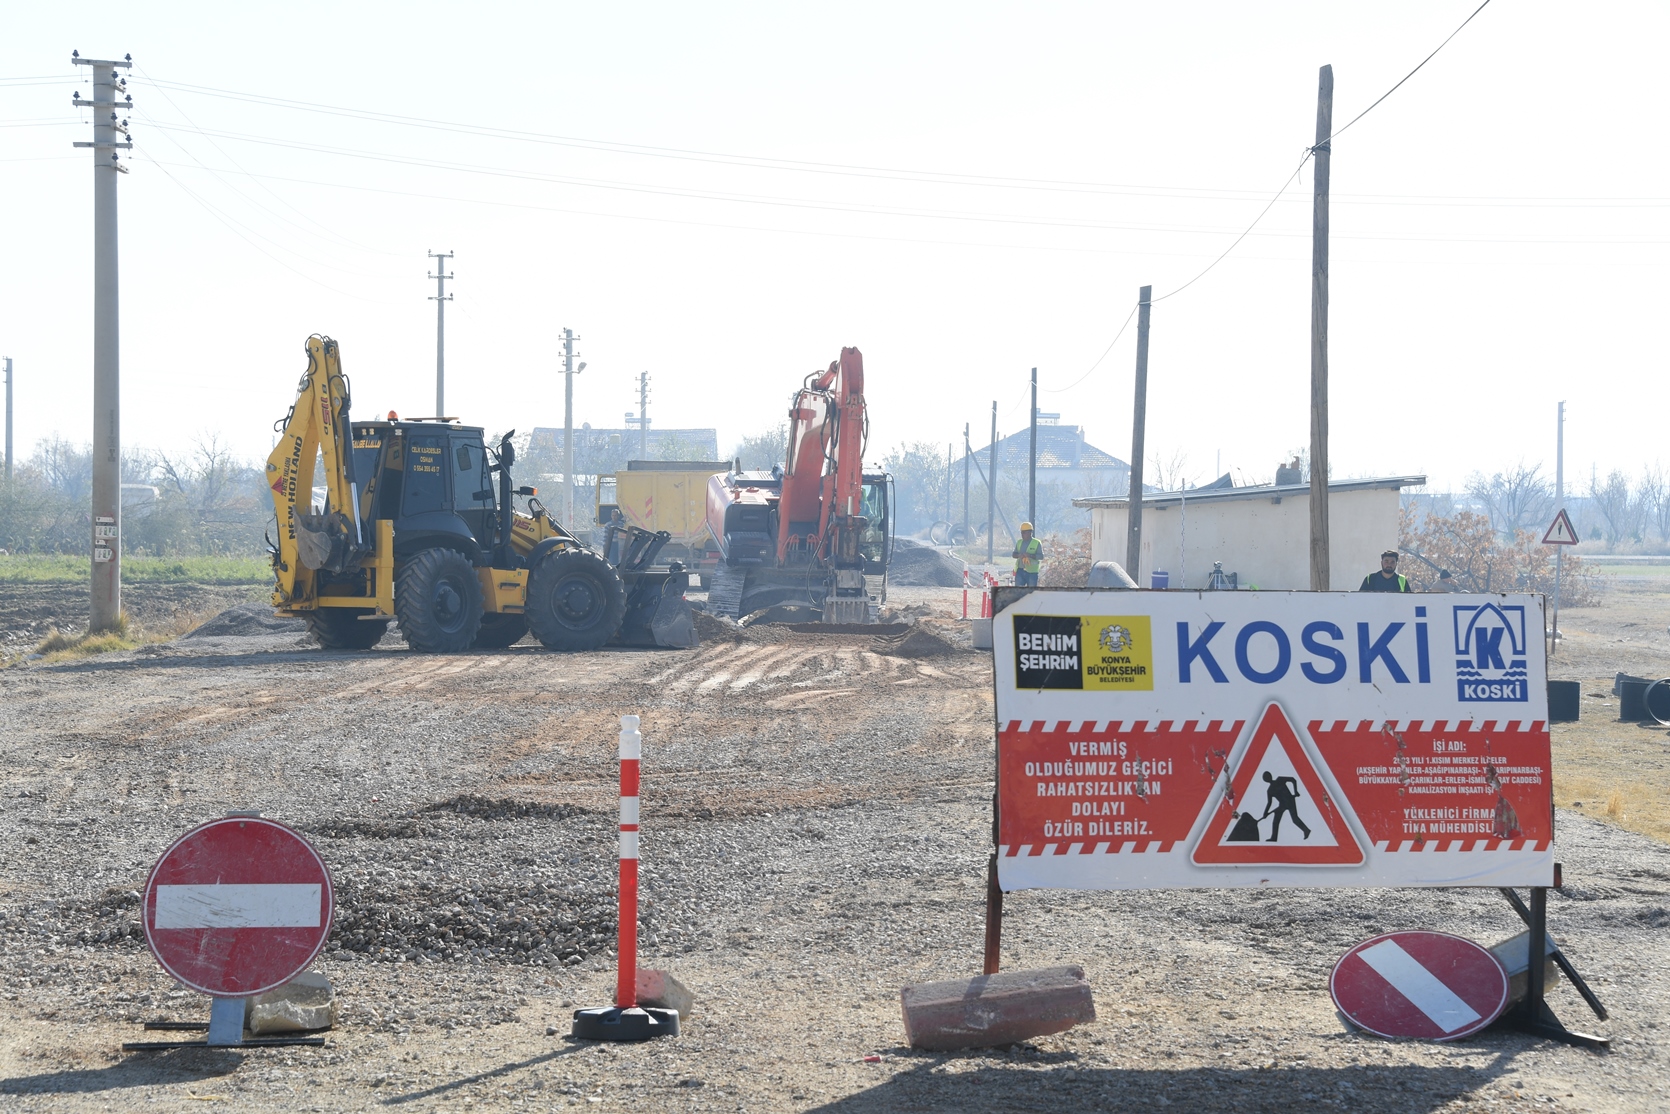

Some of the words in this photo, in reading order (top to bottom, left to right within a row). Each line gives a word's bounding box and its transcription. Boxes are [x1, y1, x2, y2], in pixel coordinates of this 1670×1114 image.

[1018, 632, 1078, 652] BENİM
[1176, 606, 1431, 684] KOSKİ
[1474, 627, 1506, 670] K
[1020, 654, 1078, 672] ŞEHRİM
[1102, 656, 1130, 664] KONYA
[1087, 664, 1146, 676] BÜYÜKŞEHİR
[1464, 682, 1520, 699] KOSKİ
[1069, 739, 1127, 759] VERMİŞ
[1448, 741, 1466, 751] ADI:
[1025, 759, 1117, 776] OLDUĞUMUZ
[1122, 758, 1172, 778] GEÇİCİ
[1408, 785, 1457, 794] KANALİZASYON
[1458, 785, 1483, 795] İNŞAATI
[1072, 802, 1125, 816] DOLAYI
[1403, 806, 1459, 819] YÜKLENİCİ
[1044, 820, 1083, 837] ÖZÜR
[1089, 818, 1152, 836] DİLERİZ.
[1402, 821, 1426, 833] TİKA
[1430, 821, 1494, 833] MÜHENDİSLİ
